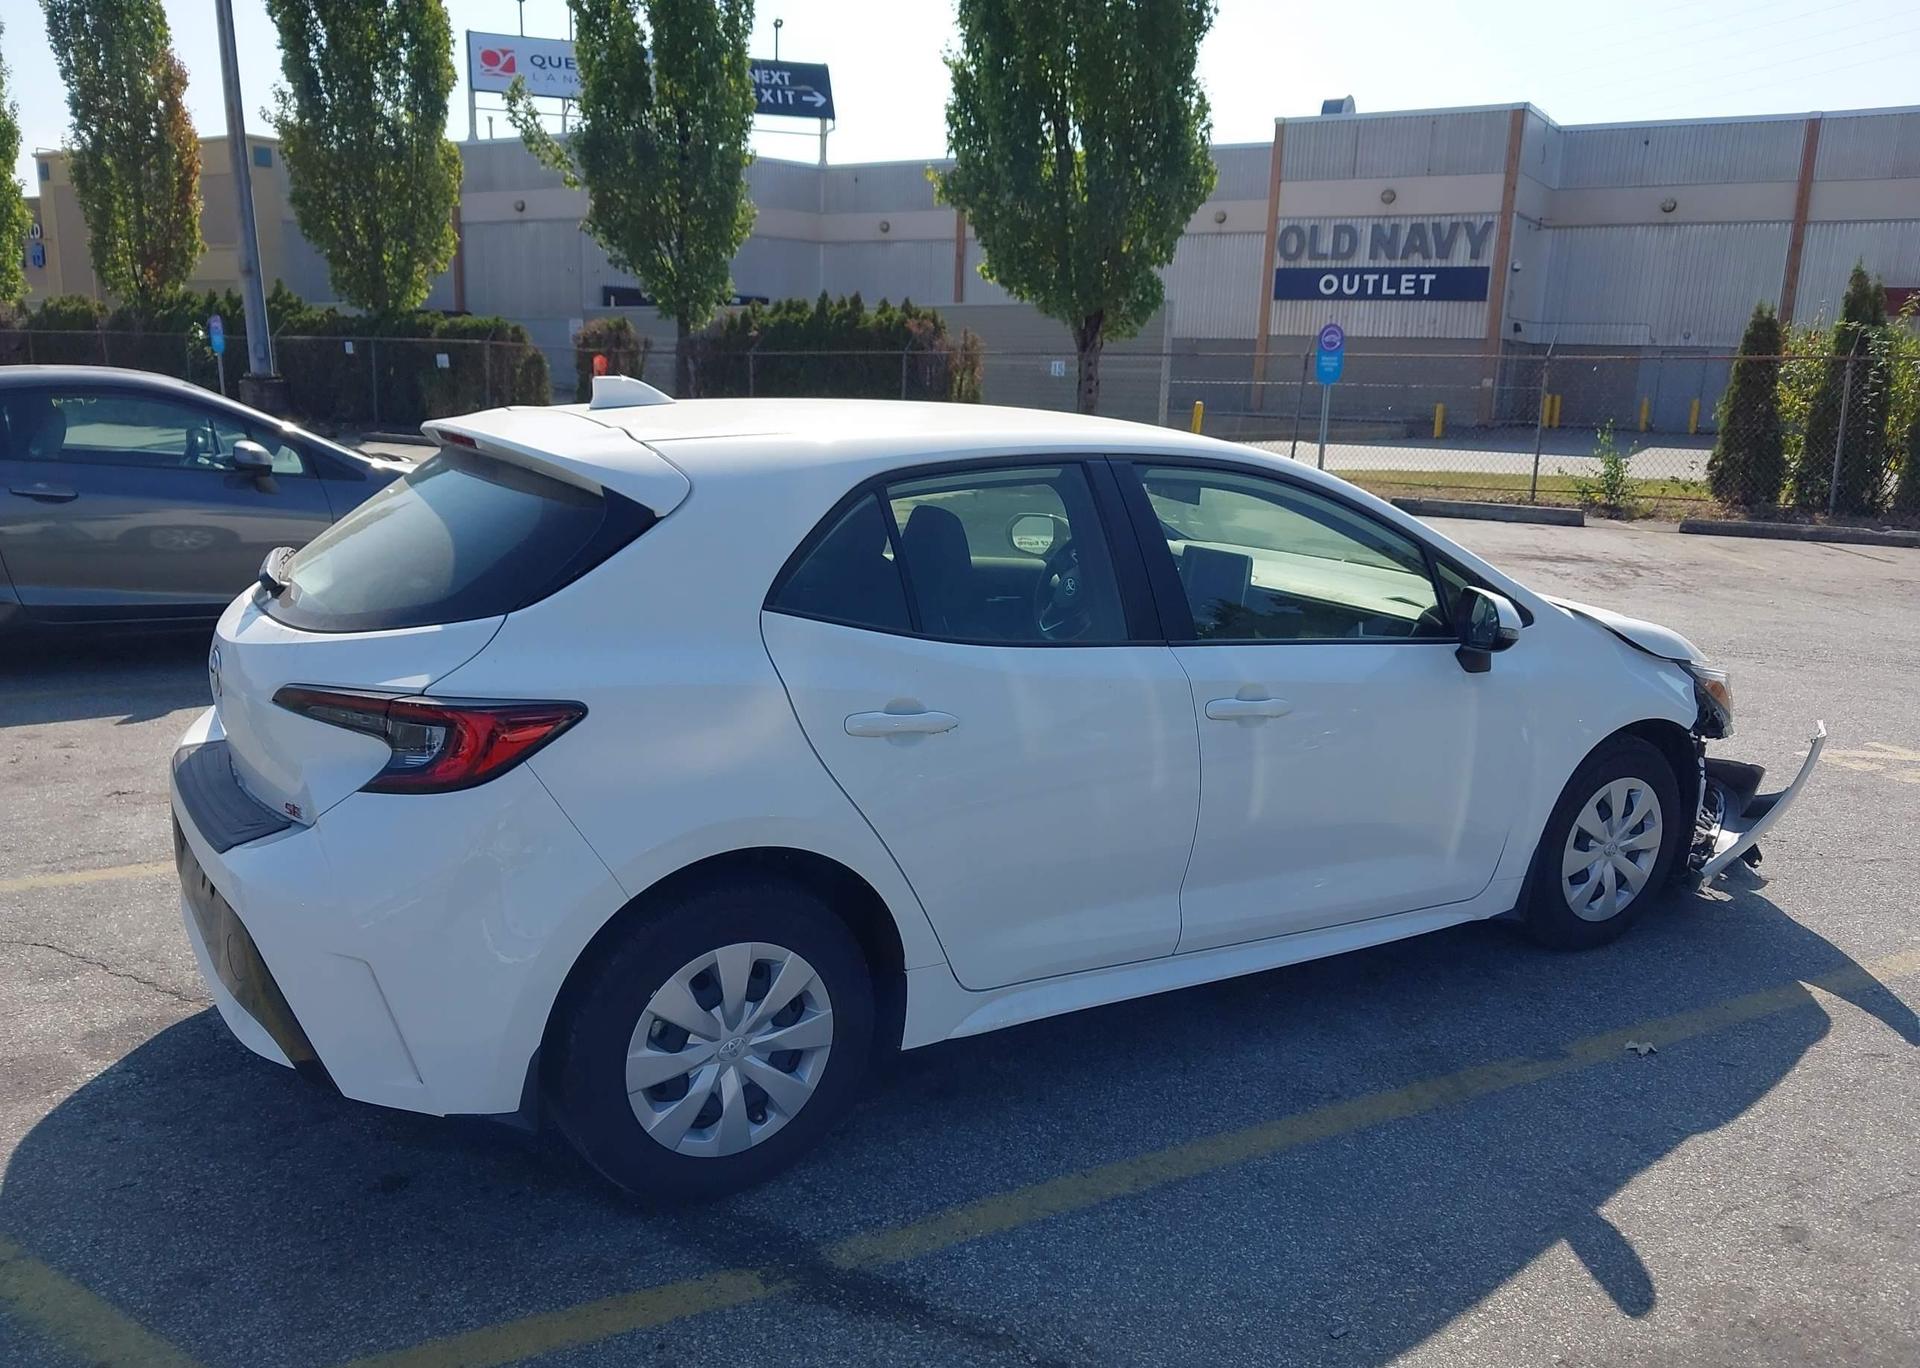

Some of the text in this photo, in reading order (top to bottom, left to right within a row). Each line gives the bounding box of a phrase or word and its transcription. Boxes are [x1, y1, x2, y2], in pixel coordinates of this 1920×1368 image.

[749, 69, 791, 86] NEXT
[1278, 221, 1494, 261] OLD NAVY
[1318, 274, 1437, 295] OUTLET
